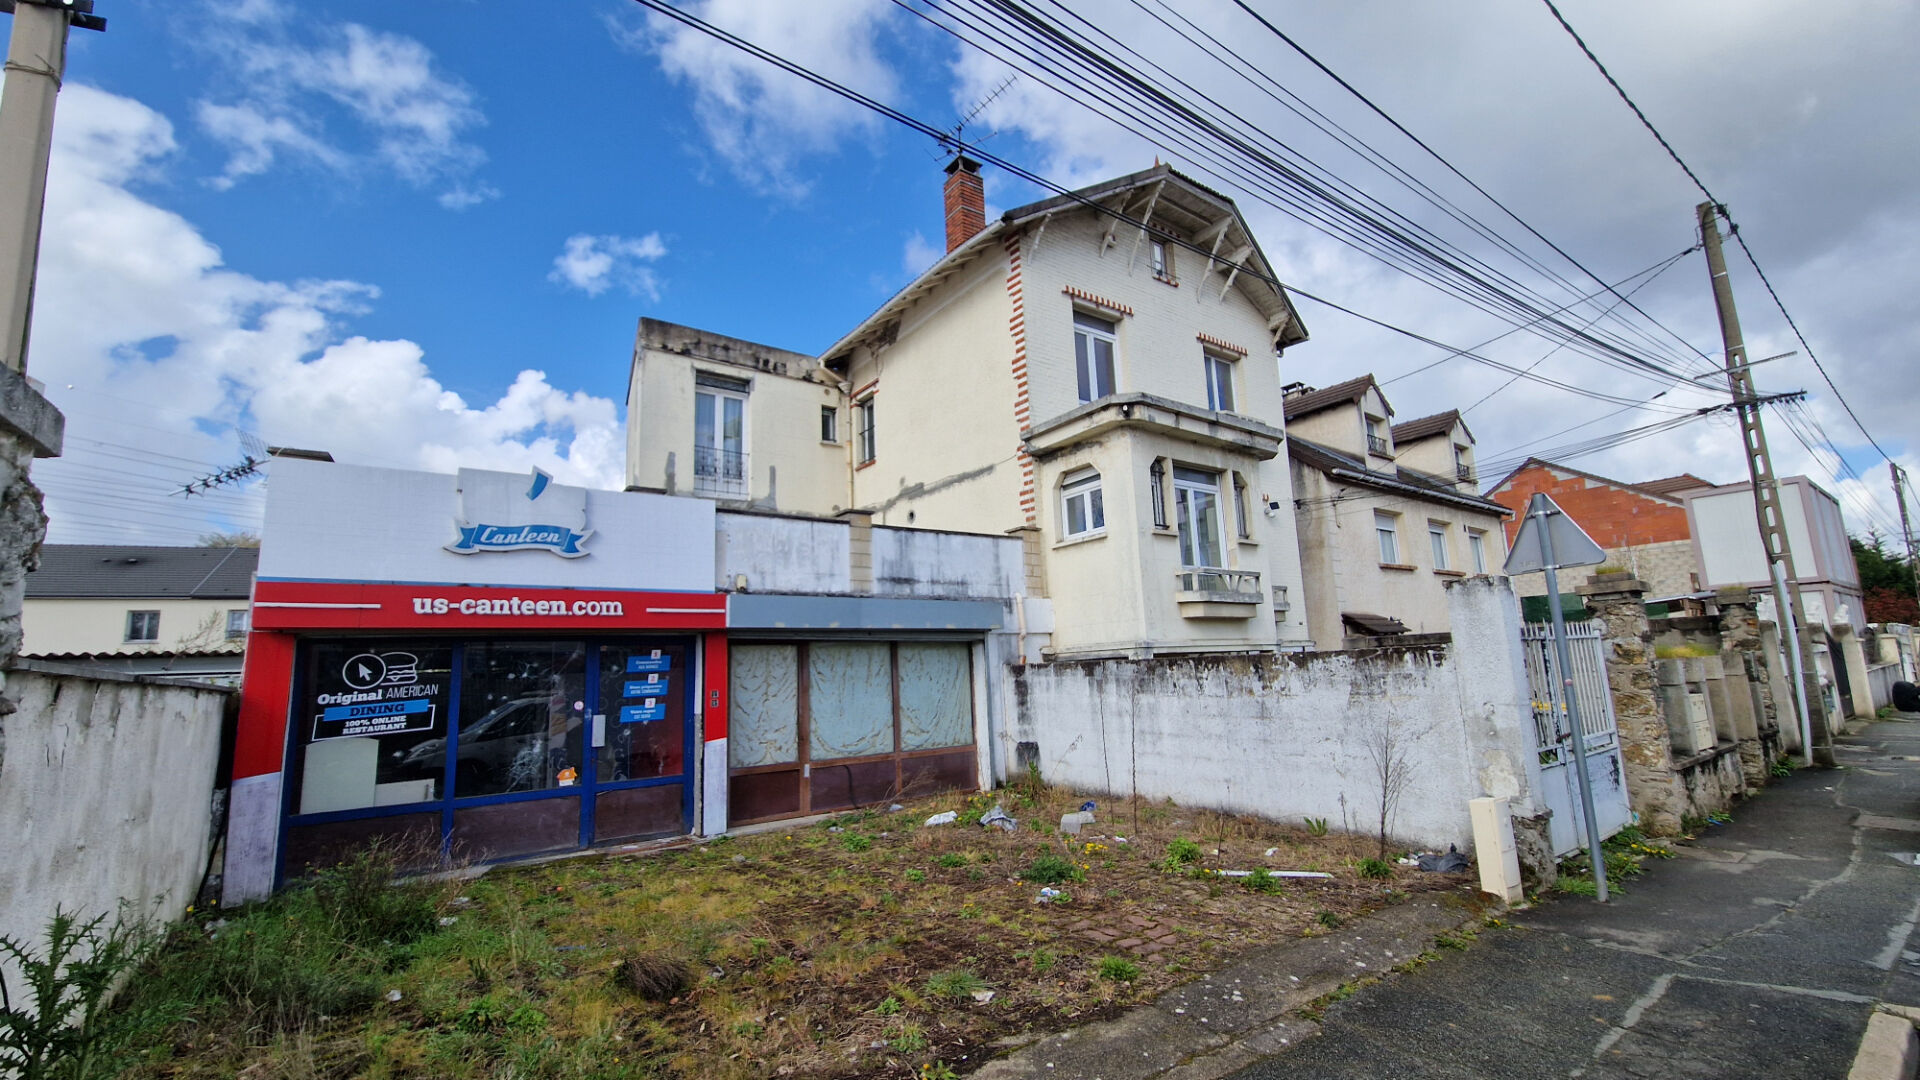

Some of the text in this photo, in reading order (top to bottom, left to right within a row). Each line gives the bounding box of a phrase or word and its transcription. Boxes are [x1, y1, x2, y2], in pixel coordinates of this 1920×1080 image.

[479, 526, 561, 544] Canteen
[412, 596, 624, 616] us-canteen.com
[317, 684, 438, 705] Original AMERICAN
[350, 704, 405, 716] DINING
[342, 723, 407, 734] RESTAURANT
[345, 716, 407, 728] 100% ONLINE
